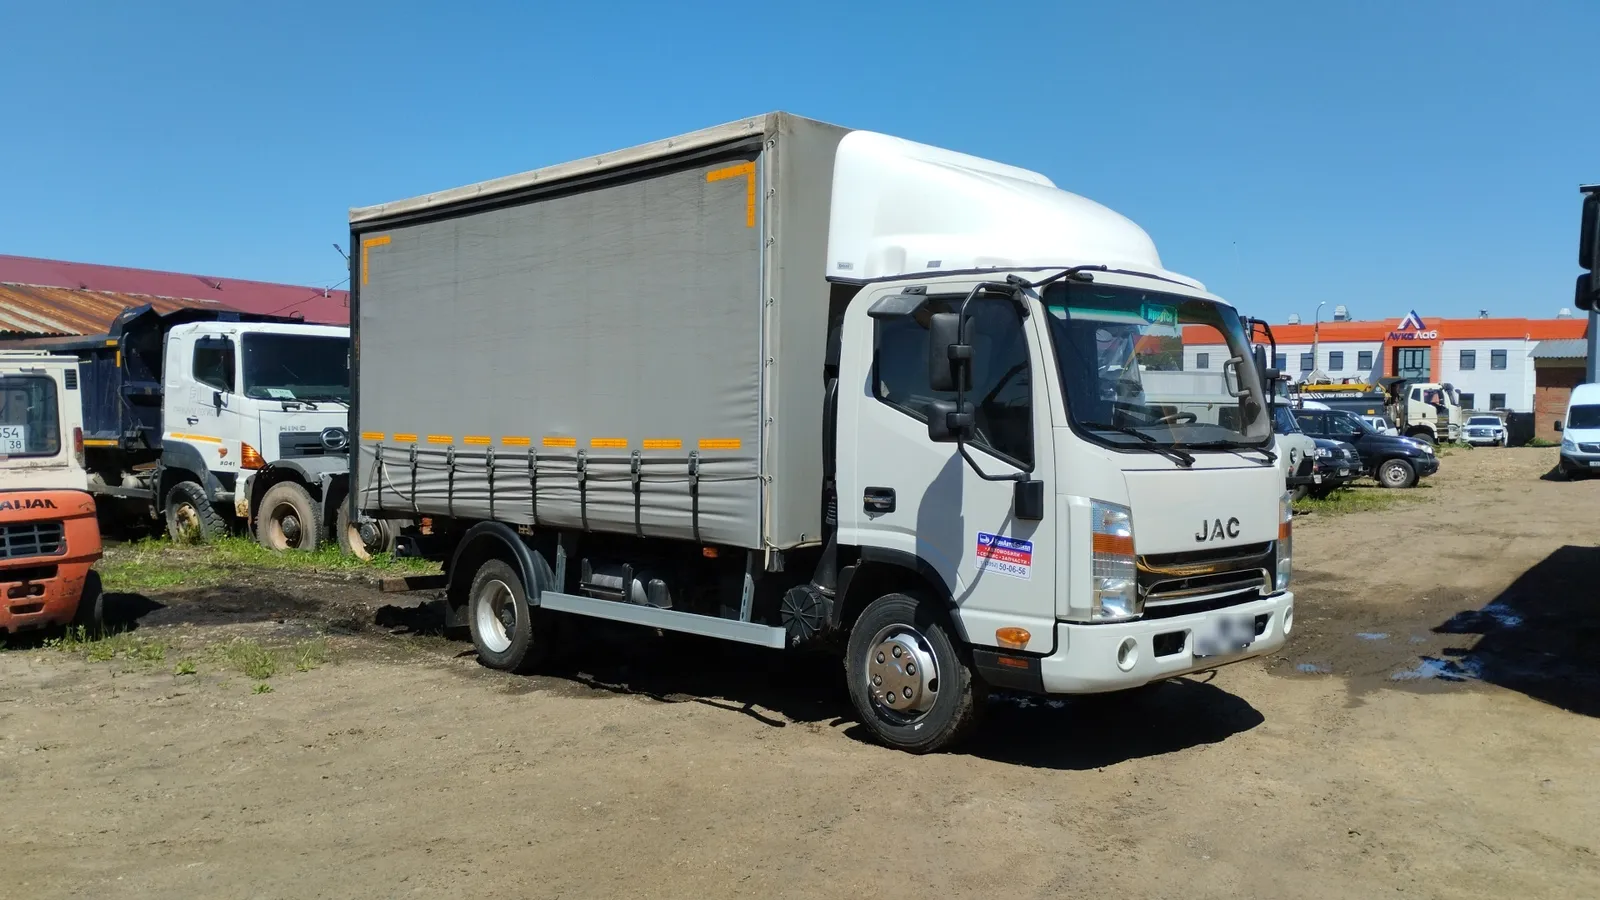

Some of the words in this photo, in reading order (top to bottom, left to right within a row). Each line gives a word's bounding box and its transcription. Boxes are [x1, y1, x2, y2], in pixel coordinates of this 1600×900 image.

[0, 427, 19, 439] 54
[9, 440, 22, 449] 38
[1195, 516, 1240, 543] JAC
[999, 562, 1026, 575] 50-06-56
